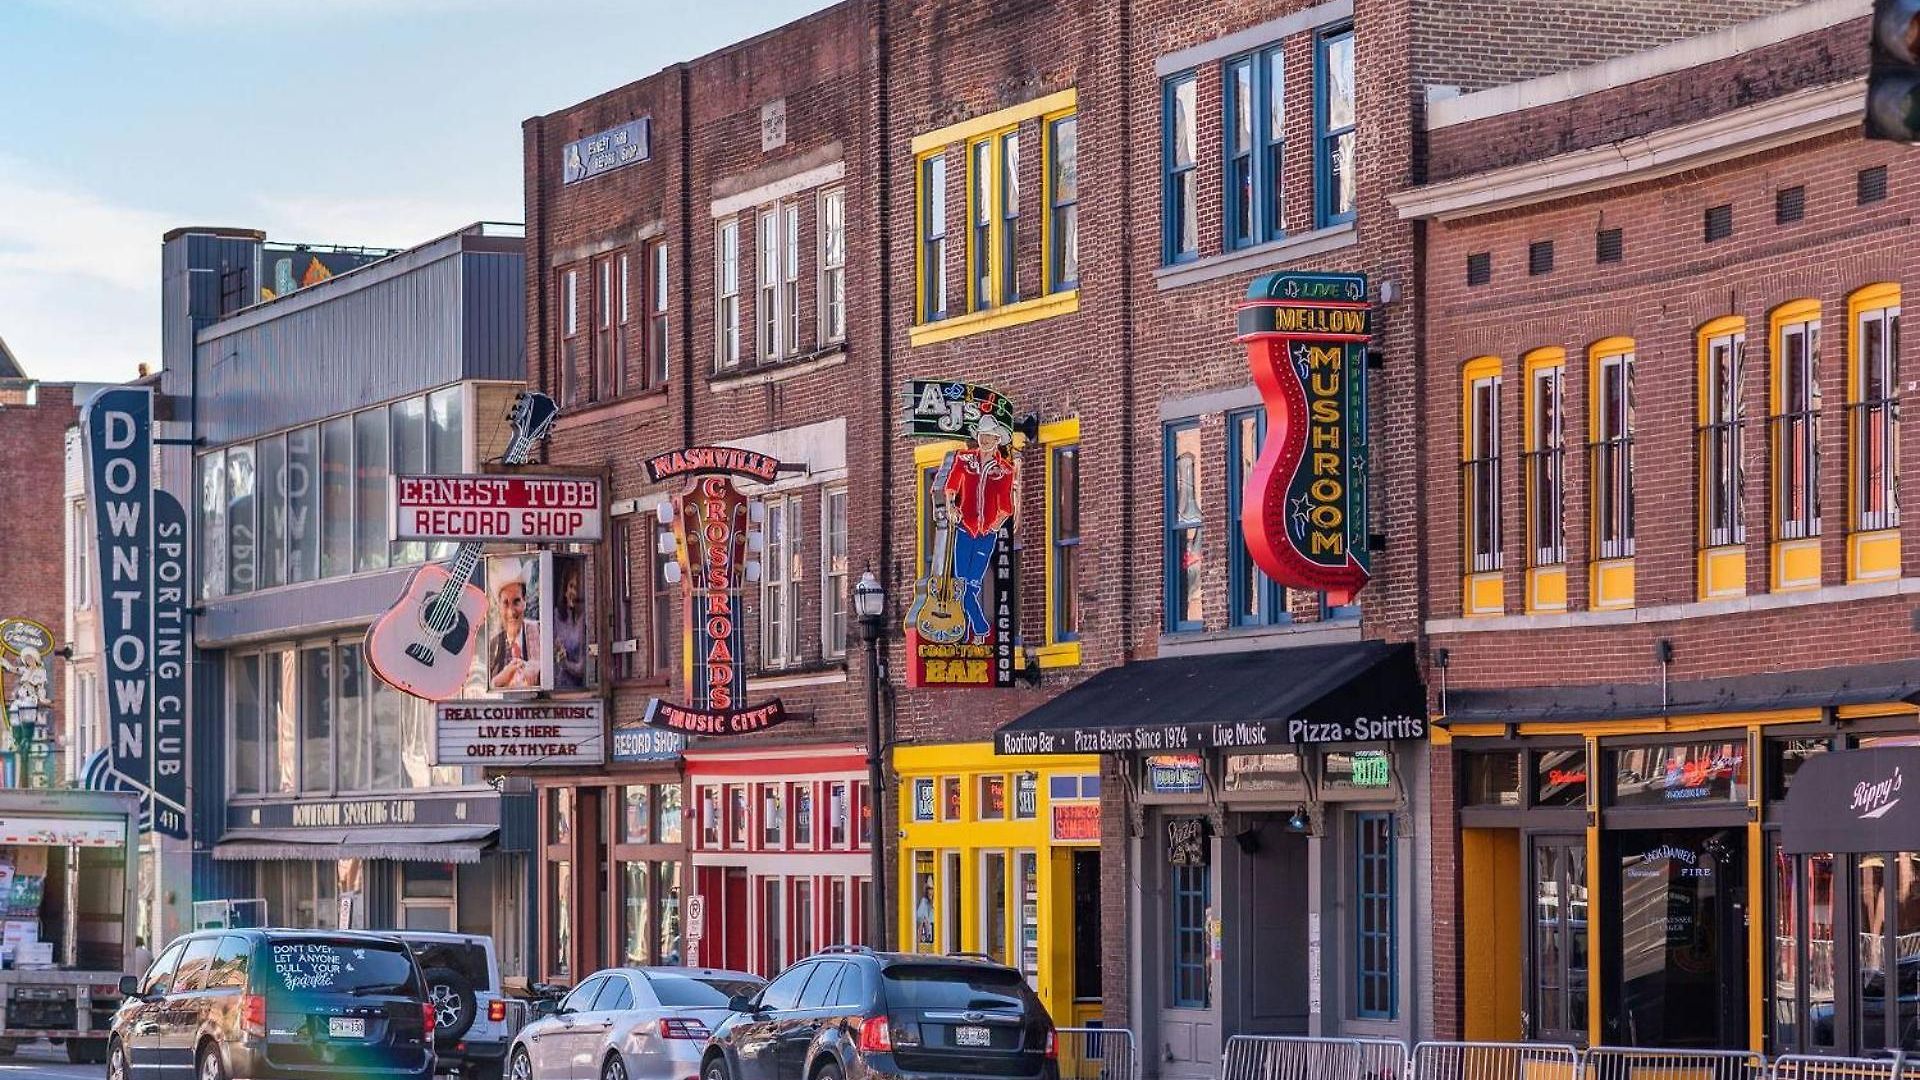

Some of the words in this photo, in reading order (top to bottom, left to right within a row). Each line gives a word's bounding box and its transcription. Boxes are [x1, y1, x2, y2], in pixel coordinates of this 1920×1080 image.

[1275, 307, 1366, 332] MELLOW
[653, 448, 777, 479] NASHVILLE
[1310, 346, 1343, 556] MUSHROOM
[401, 479, 509, 505] ERNEST
[524, 481, 596, 506] TUBB
[415, 510, 511, 537] RECORD
[521, 512, 584, 537] SHOP
[998, 527, 1010, 580] ALAN
[104, 410, 146, 759] DOWNTOWN
[702, 477, 733, 711] CROSSROADS
[158, 521, 182, 681] SPORTING
[998, 591, 1010, 684] JACKSON
[925, 659, 989, 683] BAR
[445, 707, 480, 720] REAL
[484, 707, 551, 720] COUNTRY
[553, 706, 595, 720] MUSIC
[158, 694, 182, 778] CLUB
[478, 725, 521, 738] LIVES
[524, 725, 562, 738] HERE
[1004, 733, 1038, 754] Rooftop
[1039, 733, 1054, 751] Bar
[1074, 730, 1099, 753] Pizza
[1099, 729, 1132, 751] Bakers
[1134, 728, 1161, 750] Since
[1163, 727, 1188, 749] 1974
[1212, 724, 1235, 747] Live
[1236, 722, 1267, 746] Music
[1288, 717, 1342, 743] Pizza
[1355, 714, 1423, 740] Spirits
[466, 744, 497, 758] OUR
[500, 744, 537, 758] 74TH
[537, 744, 578, 758] YEAR
[614, 733, 652, 755] RECORD
[1850, 766, 1903, 812] Rippy's
[159, 810, 180, 832] 411
[292, 803, 340, 826] DOWNTOWN
[342, 801, 388, 825] SPORTING
[391, 800, 416, 823] CLUB
[1642, 847, 1663, 865] JACK
[1661, 845, 1697, 865] DANIEL'S
[1680, 868, 1712, 877] FIRE
[274, 955, 291, 964] LET
[298, 954, 340, 965] ANYONE
[276, 964, 303, 974] DULL
[311, 963, 341, 974] YOUR
